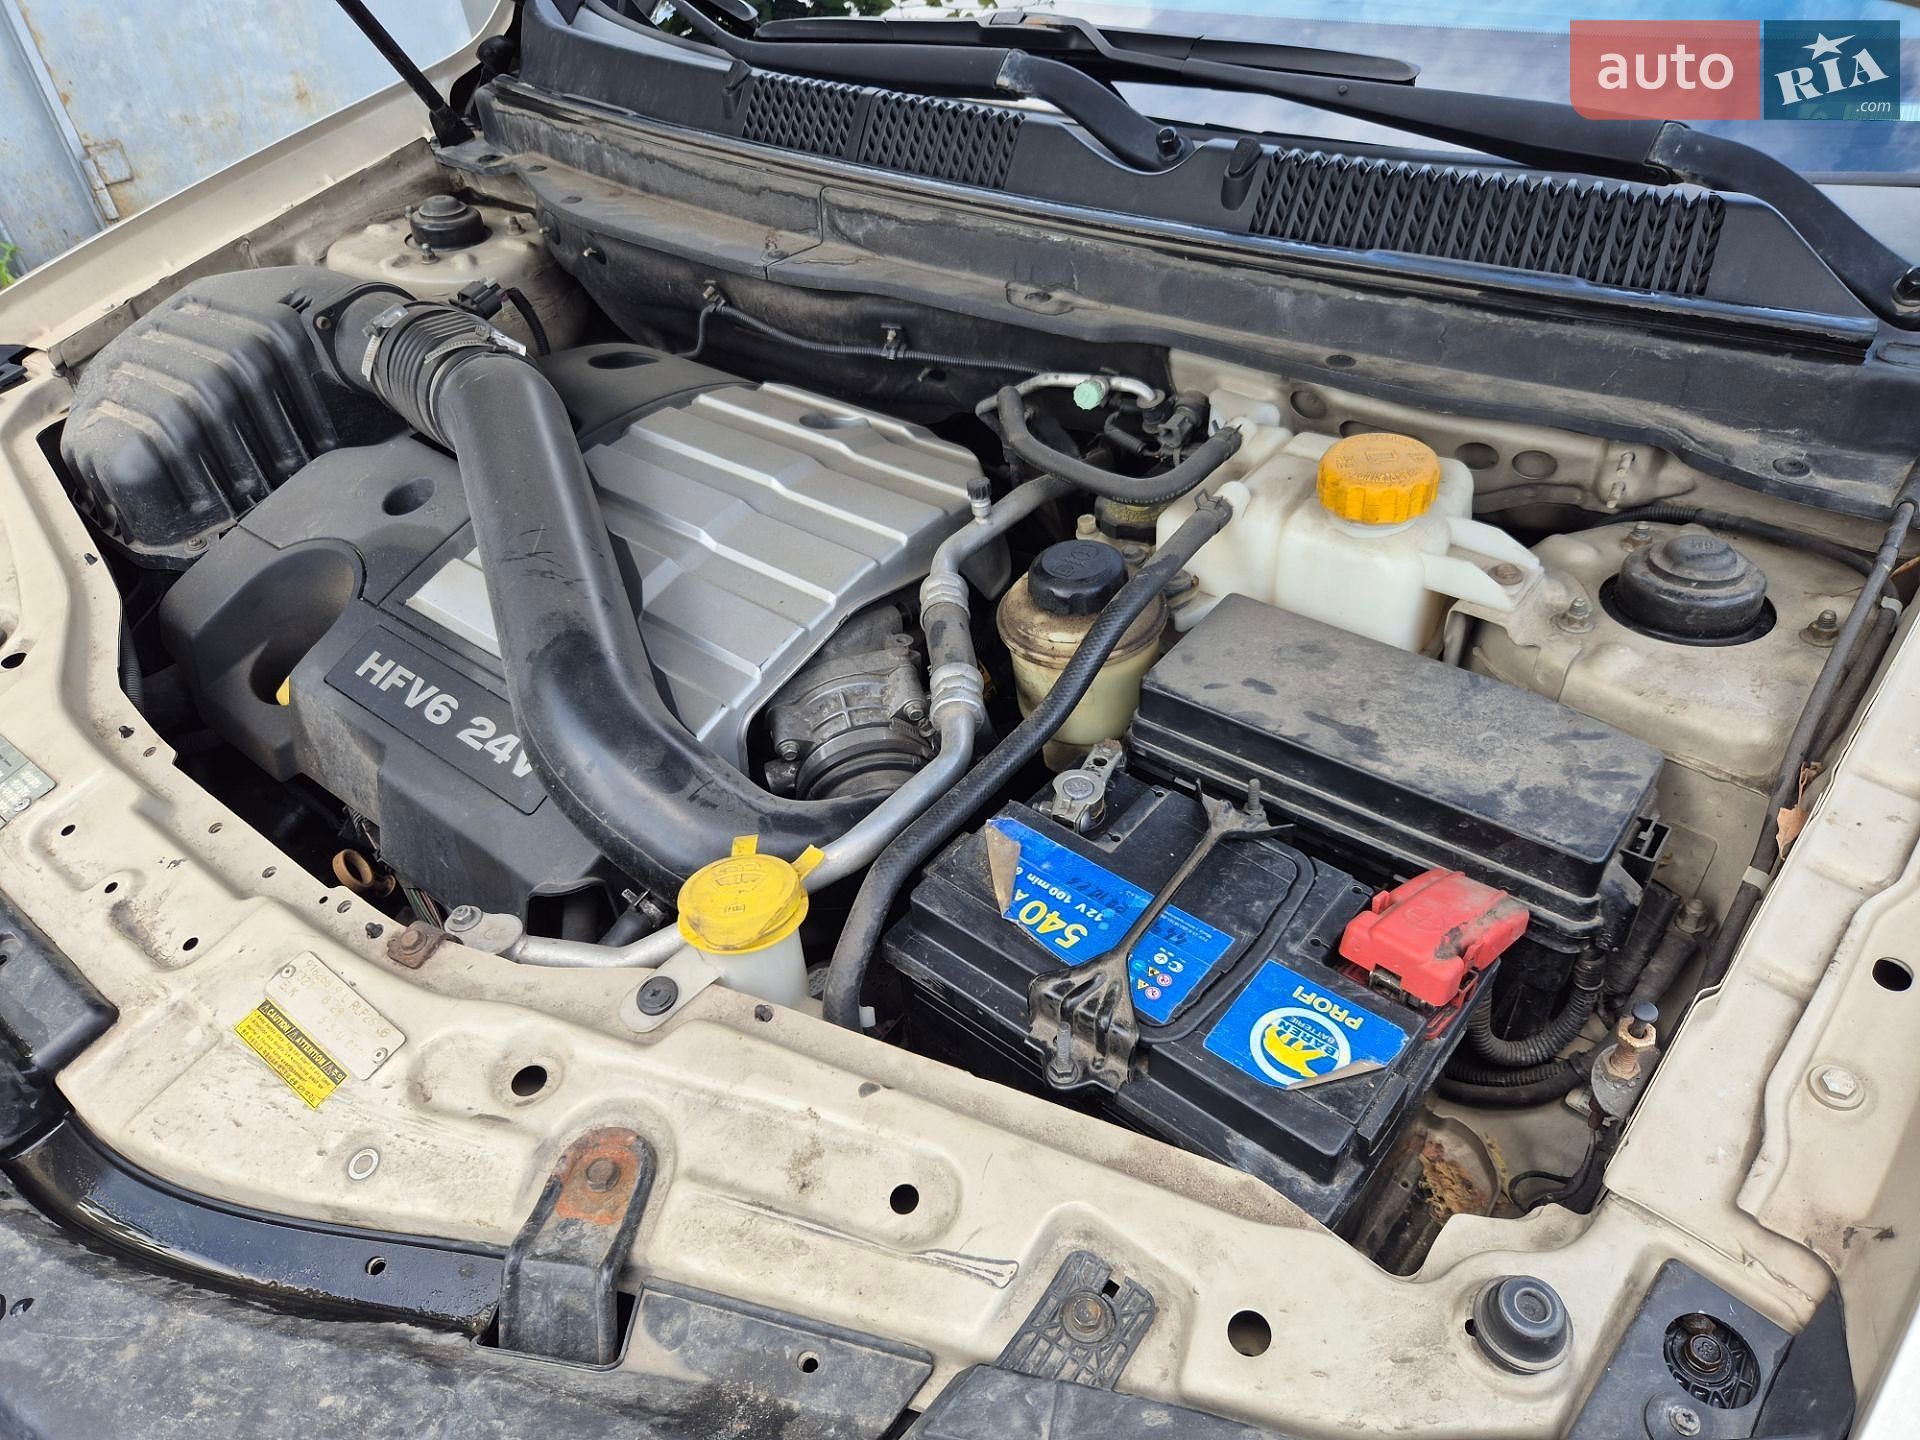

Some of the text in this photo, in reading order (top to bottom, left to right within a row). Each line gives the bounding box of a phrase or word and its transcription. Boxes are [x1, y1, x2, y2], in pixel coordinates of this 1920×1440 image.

[355, 651, 459, 725] HFV6
[1013, 889, 1088, 949] 540 A
[1075, 903, 1104, 921] 12V
[1291, 1016, 1336, 1044] BATTERIE
[1292, 985, 1364, 1031] PROFI
